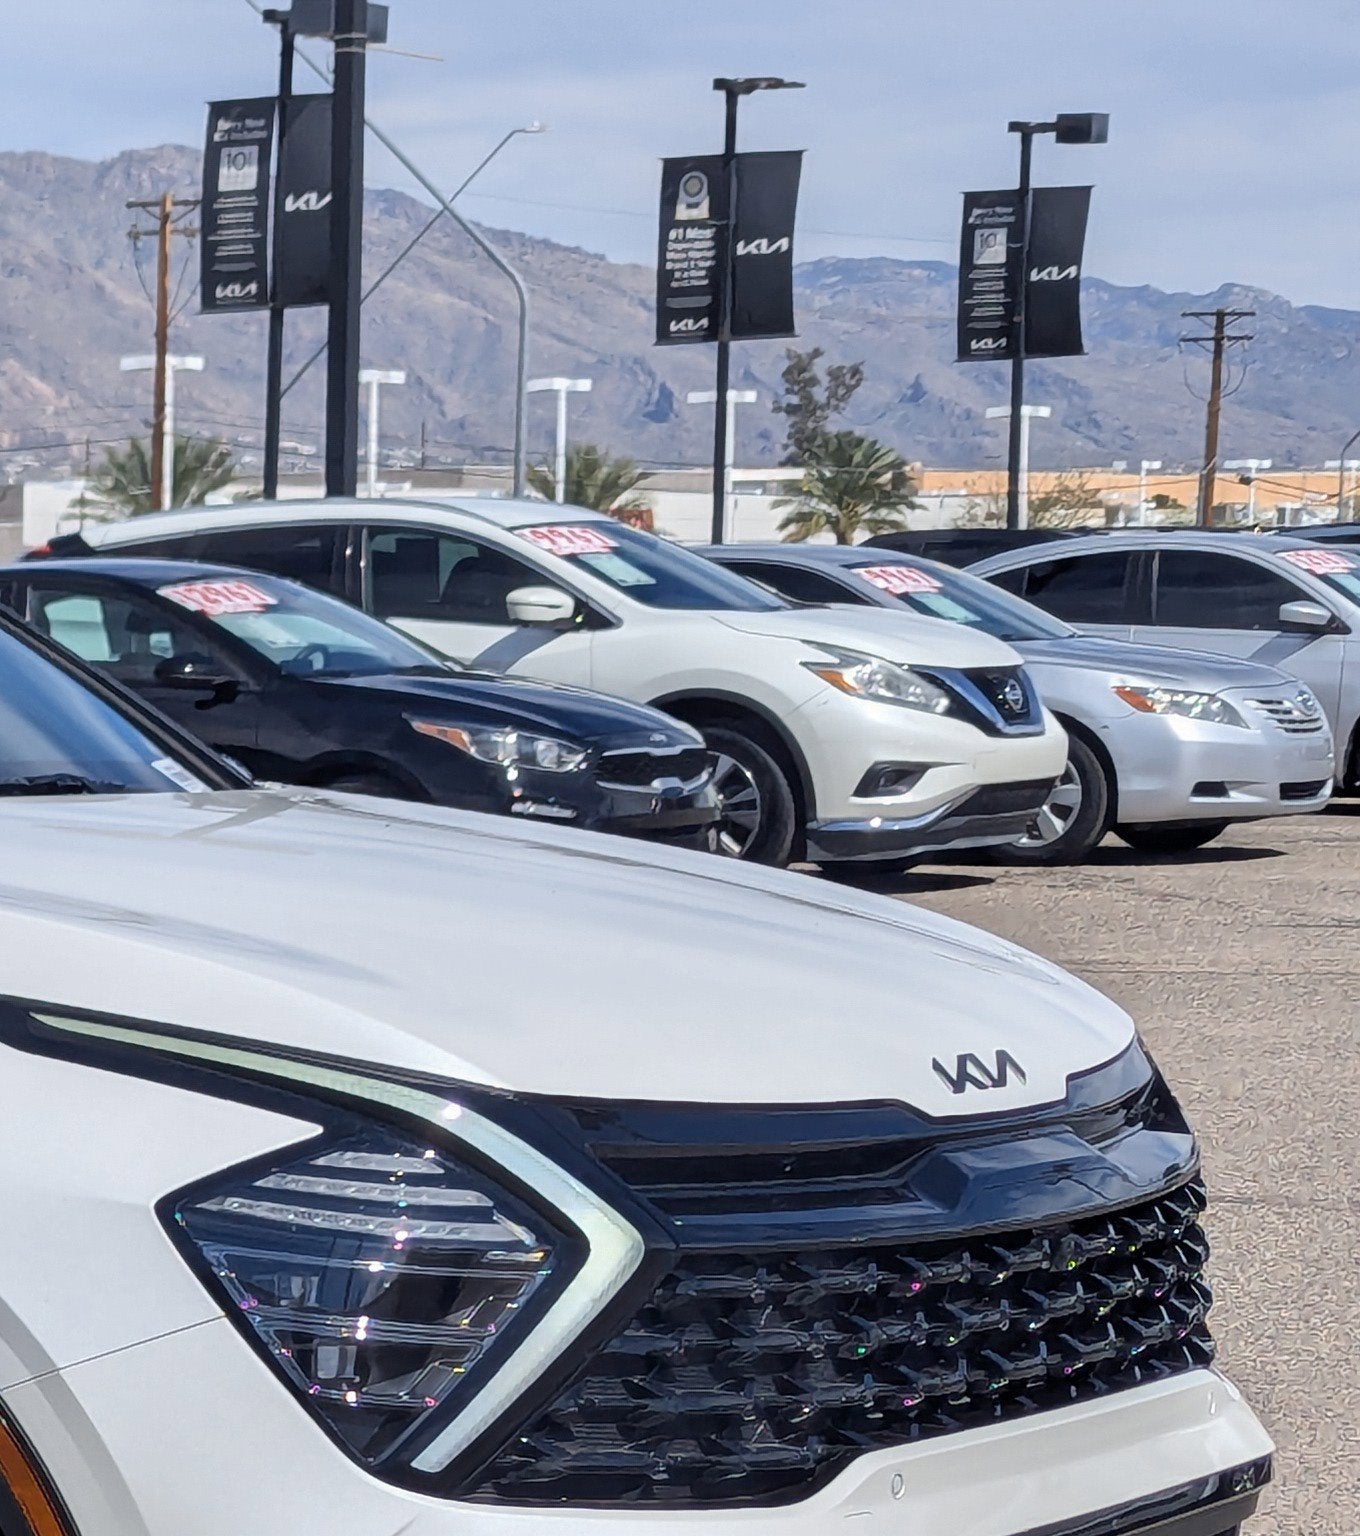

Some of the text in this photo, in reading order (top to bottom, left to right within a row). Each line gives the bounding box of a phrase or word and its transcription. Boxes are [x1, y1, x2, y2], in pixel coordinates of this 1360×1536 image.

[736, 236, 789, 255] KIA
[1030, 264, 1078, 282] KIA
[932, 1049, 1027, 1094] KIA
